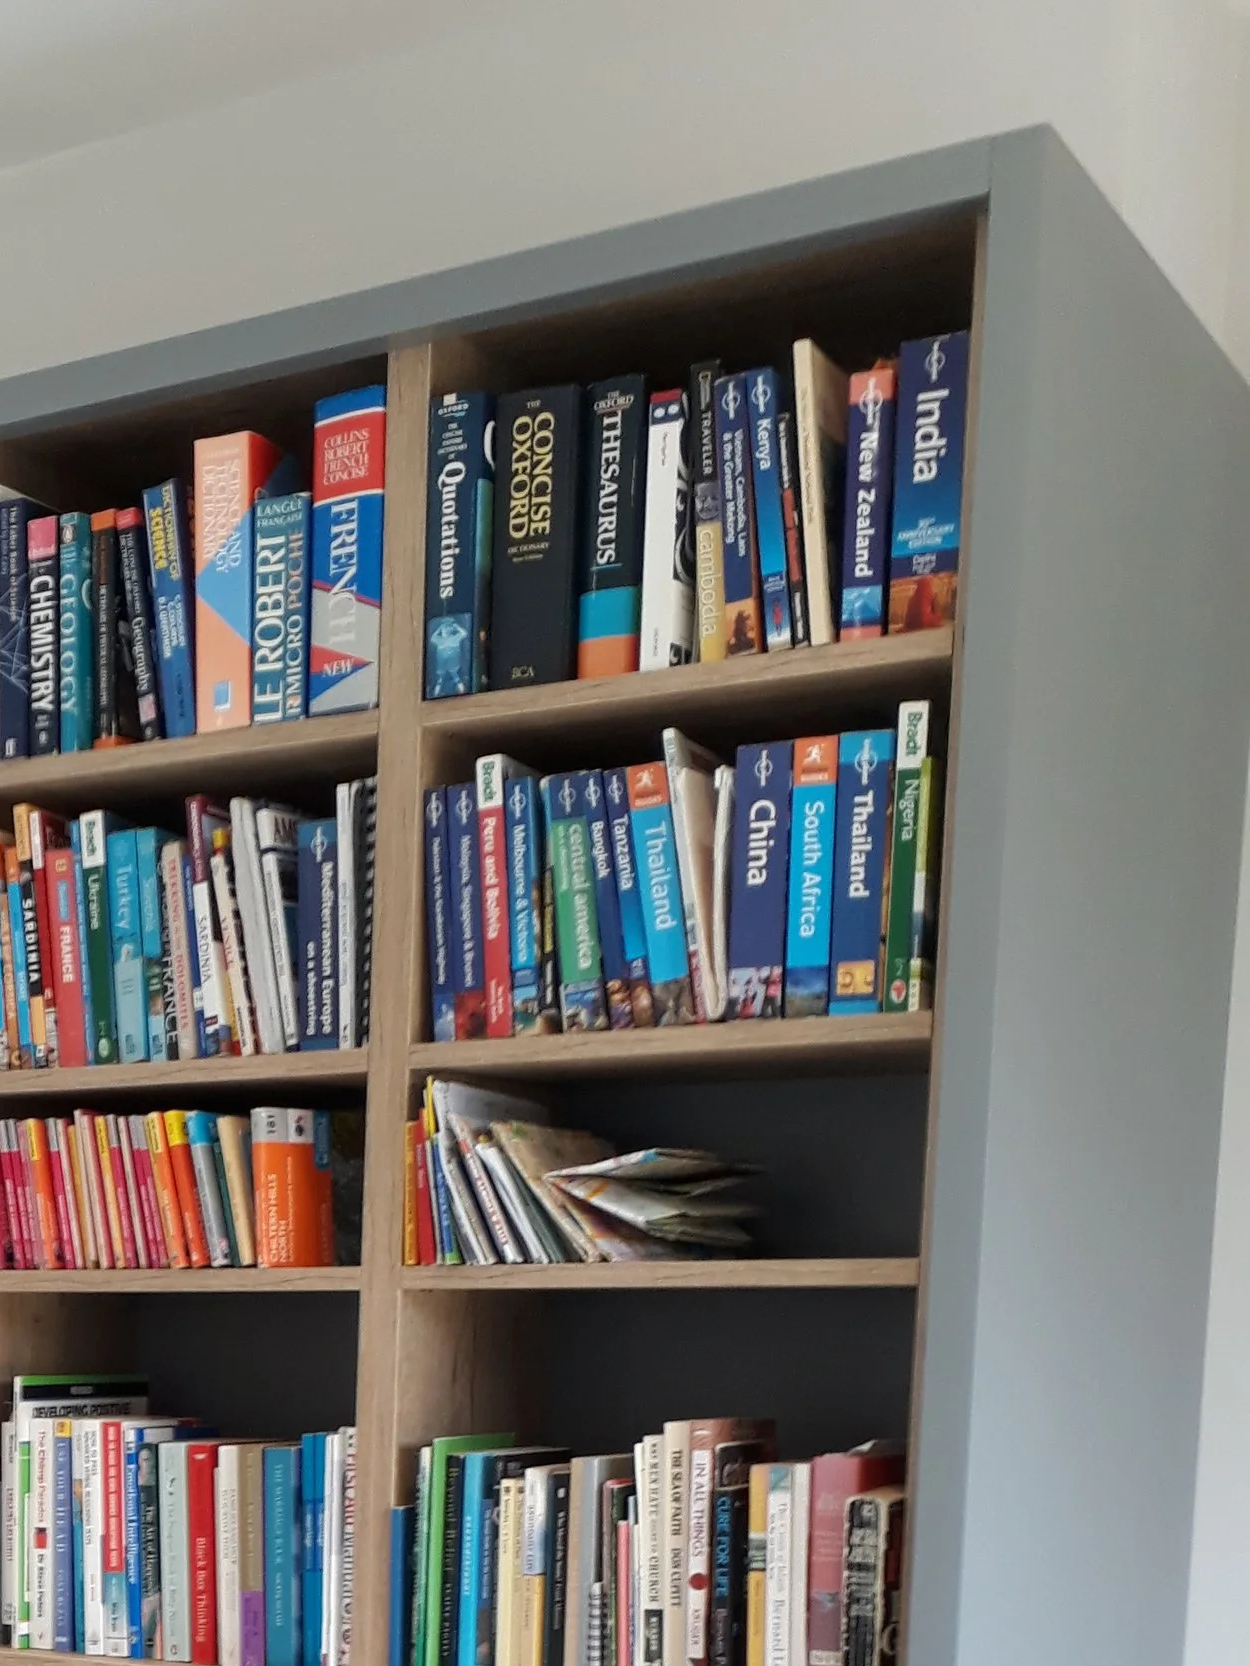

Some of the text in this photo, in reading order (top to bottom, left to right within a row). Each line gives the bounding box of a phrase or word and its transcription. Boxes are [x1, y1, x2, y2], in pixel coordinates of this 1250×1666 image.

[323, 427, 370, 449] COLLINS
[592, 393, 635, 412] OXFORD
[701, 411, 713, 475] TRAVELER
[913, 388, 950, 484] India
[322, 463, 369, 486] CONCISE
[323, 440, 368, 462] ROBERT
[323, 452, 369, 474] FRENCH
[508, 414, 534, 540] OXFORD
[530, 411, 556, 537] CONCISE
[757, 418, 773, 471] Kenya
[202, 464, 216, 560] DICTIONARY
[215, 463, 229, 574] TECHNOLOGY
[594, 410, 624, 566] THESAURUS
[854, 430, 878, 578] New Zealand
[149, 507, 167, 570] SCIENCE
[162, 486, 181, 581] DICTIONARY OF
[228, 529, 241, 568] AND
[436, 461, 467, 600] Quotations
[287, 532, 303, 694] MICRO POCHE
[329, 499, 359, 645] FRENCH
[697, 529, 717, 636] cambodia
[30, 575, 55, 711] CHEMISTRY
[60, 574, 78, 717] GEOLOGY
[132, 617, 152, 692] Geography
[253, 535, 286, 722] LE ROBERT
[322, 659, 355, 679] NEW
[905, 711, 923, 757] Bradt
[591, 820, 612, 880] Bangkok
[746, 798, 777, 887] China
[848, 789, 875, 899] Thailand
[899, 778, 920, 842] Nigeria
[482, 817, 500, 940] Peru and Bolivia
[513, 824, 529, 895] Melbourne
[612, 813, 635, 891] Tanzania
[645, 820, 677, 930] Thailand
[798, 801, 824, 938] South Africa
[87, 874, 100, 931] Ukraine
[115, 864, 134, 929] Turkey
[568, 823, 595, 970] central america
[22, 898, 41, 984] SARDINIA
[59, 925, 75, 983] FRANCE
[197, 915, 212, 984] SARDINIA
[306, 941, 317, 959] on
[320, 861, 334, 1035] Mediterranean Europe
[163, 955, 179, 1046] FRANCE
[305, 971, 317, 1036] shoestring
[35, 1449, 47, 1484] Chimp
[671, 1449, 682, 1470] THE
[671, 1471, 682, 1490] SEA
[126, 1463, 139, 1585] Emotional Intelligence
[444, 1467, 459, 1571] Beyond Belief
[670, 1505, 682, 1536] FAITH
[691, 1462, 706, 1558] IN ALL THINGS
[715, 1497, 729, 1598] CURE FOR LIFE
[194, 1537, 208, 1644] Black Box Thinking
[648, 1556, 660, 1603] CHURCH
[670, 1547, 682, 1609] DON CUPITT
[773, 1599, 787, 1652] Bernard
